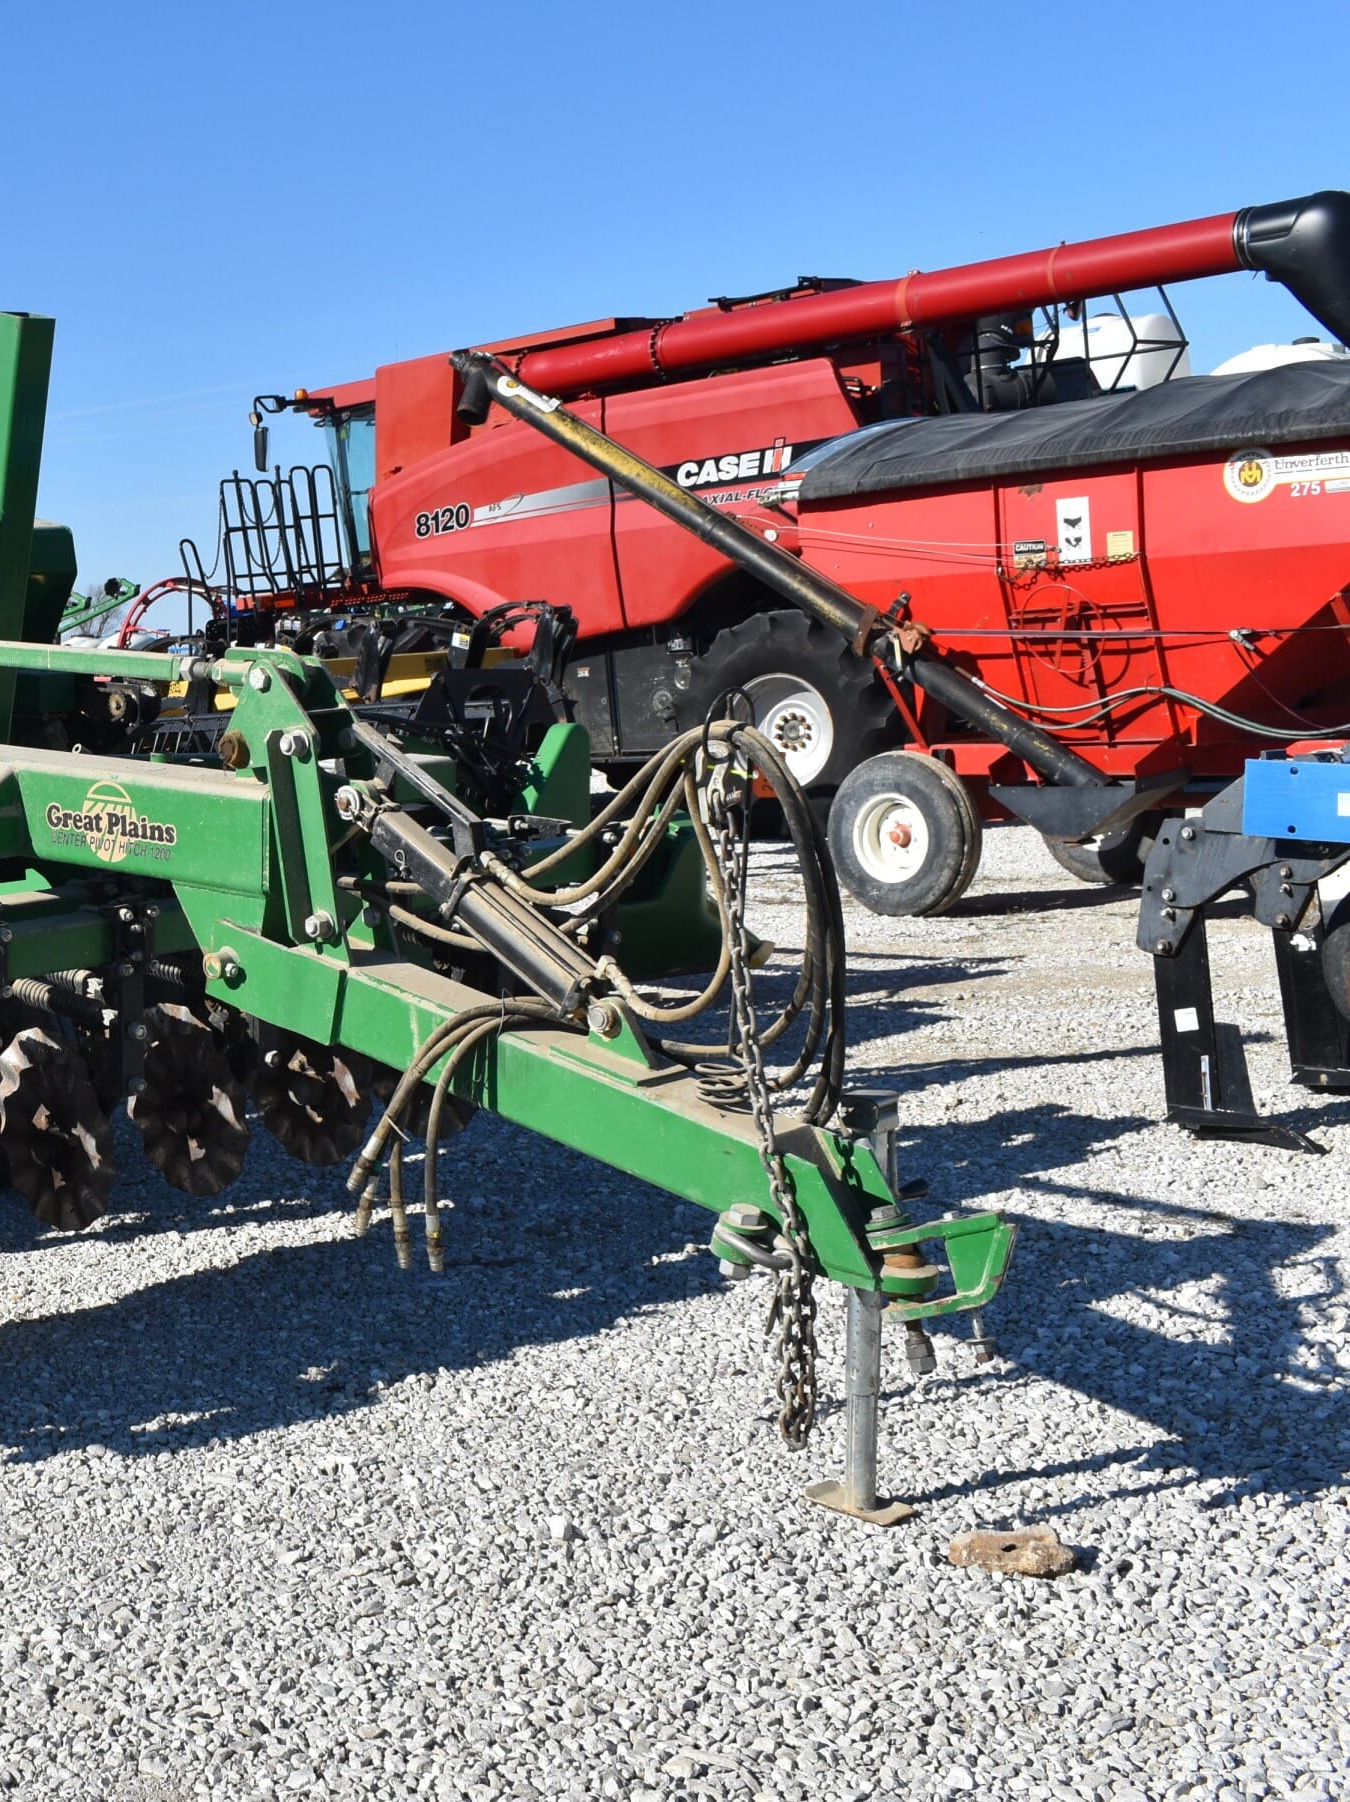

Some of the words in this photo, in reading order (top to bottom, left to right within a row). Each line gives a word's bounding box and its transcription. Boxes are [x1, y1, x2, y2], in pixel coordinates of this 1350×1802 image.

[677, 452, 761, 487] CASE
[1274, 453, 1349, 470] Unverferth
[1290, 481, 1321, 497] 275
[488, 502, 501, 512] AFS
[416, 503, 470, 538] 8120
[1015, 542, 1044, 552] CAUTION
[46, 804, 103, 833] Great
[105, 812, 176, 844] Plains
[50, 831, 87, 847] CENTER
[89, 836, 116, 851] PIVOT
[119, 840, 148, 857] HITCH
